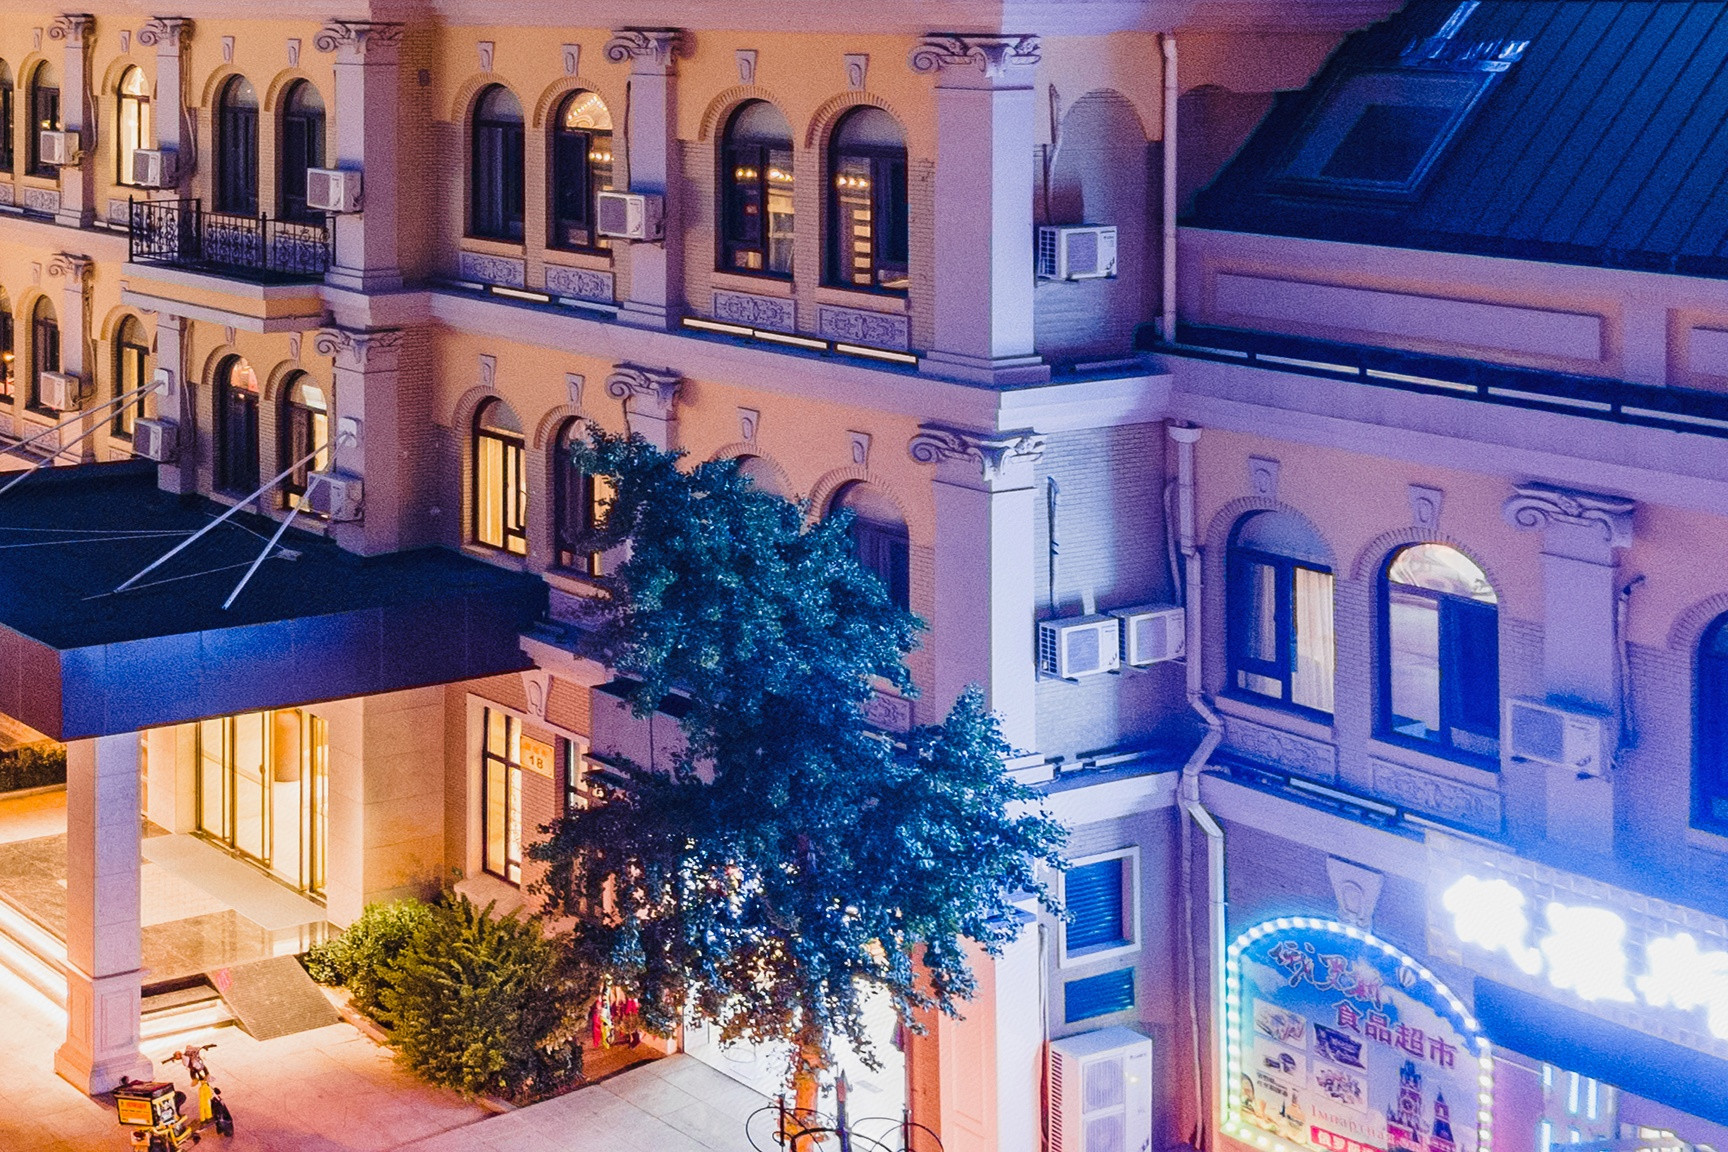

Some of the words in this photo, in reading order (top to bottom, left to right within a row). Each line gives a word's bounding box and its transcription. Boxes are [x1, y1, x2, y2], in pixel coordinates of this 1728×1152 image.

[529, 755, 543, 769] 18
[1332, 999, 1458, 1069] 食品超市
